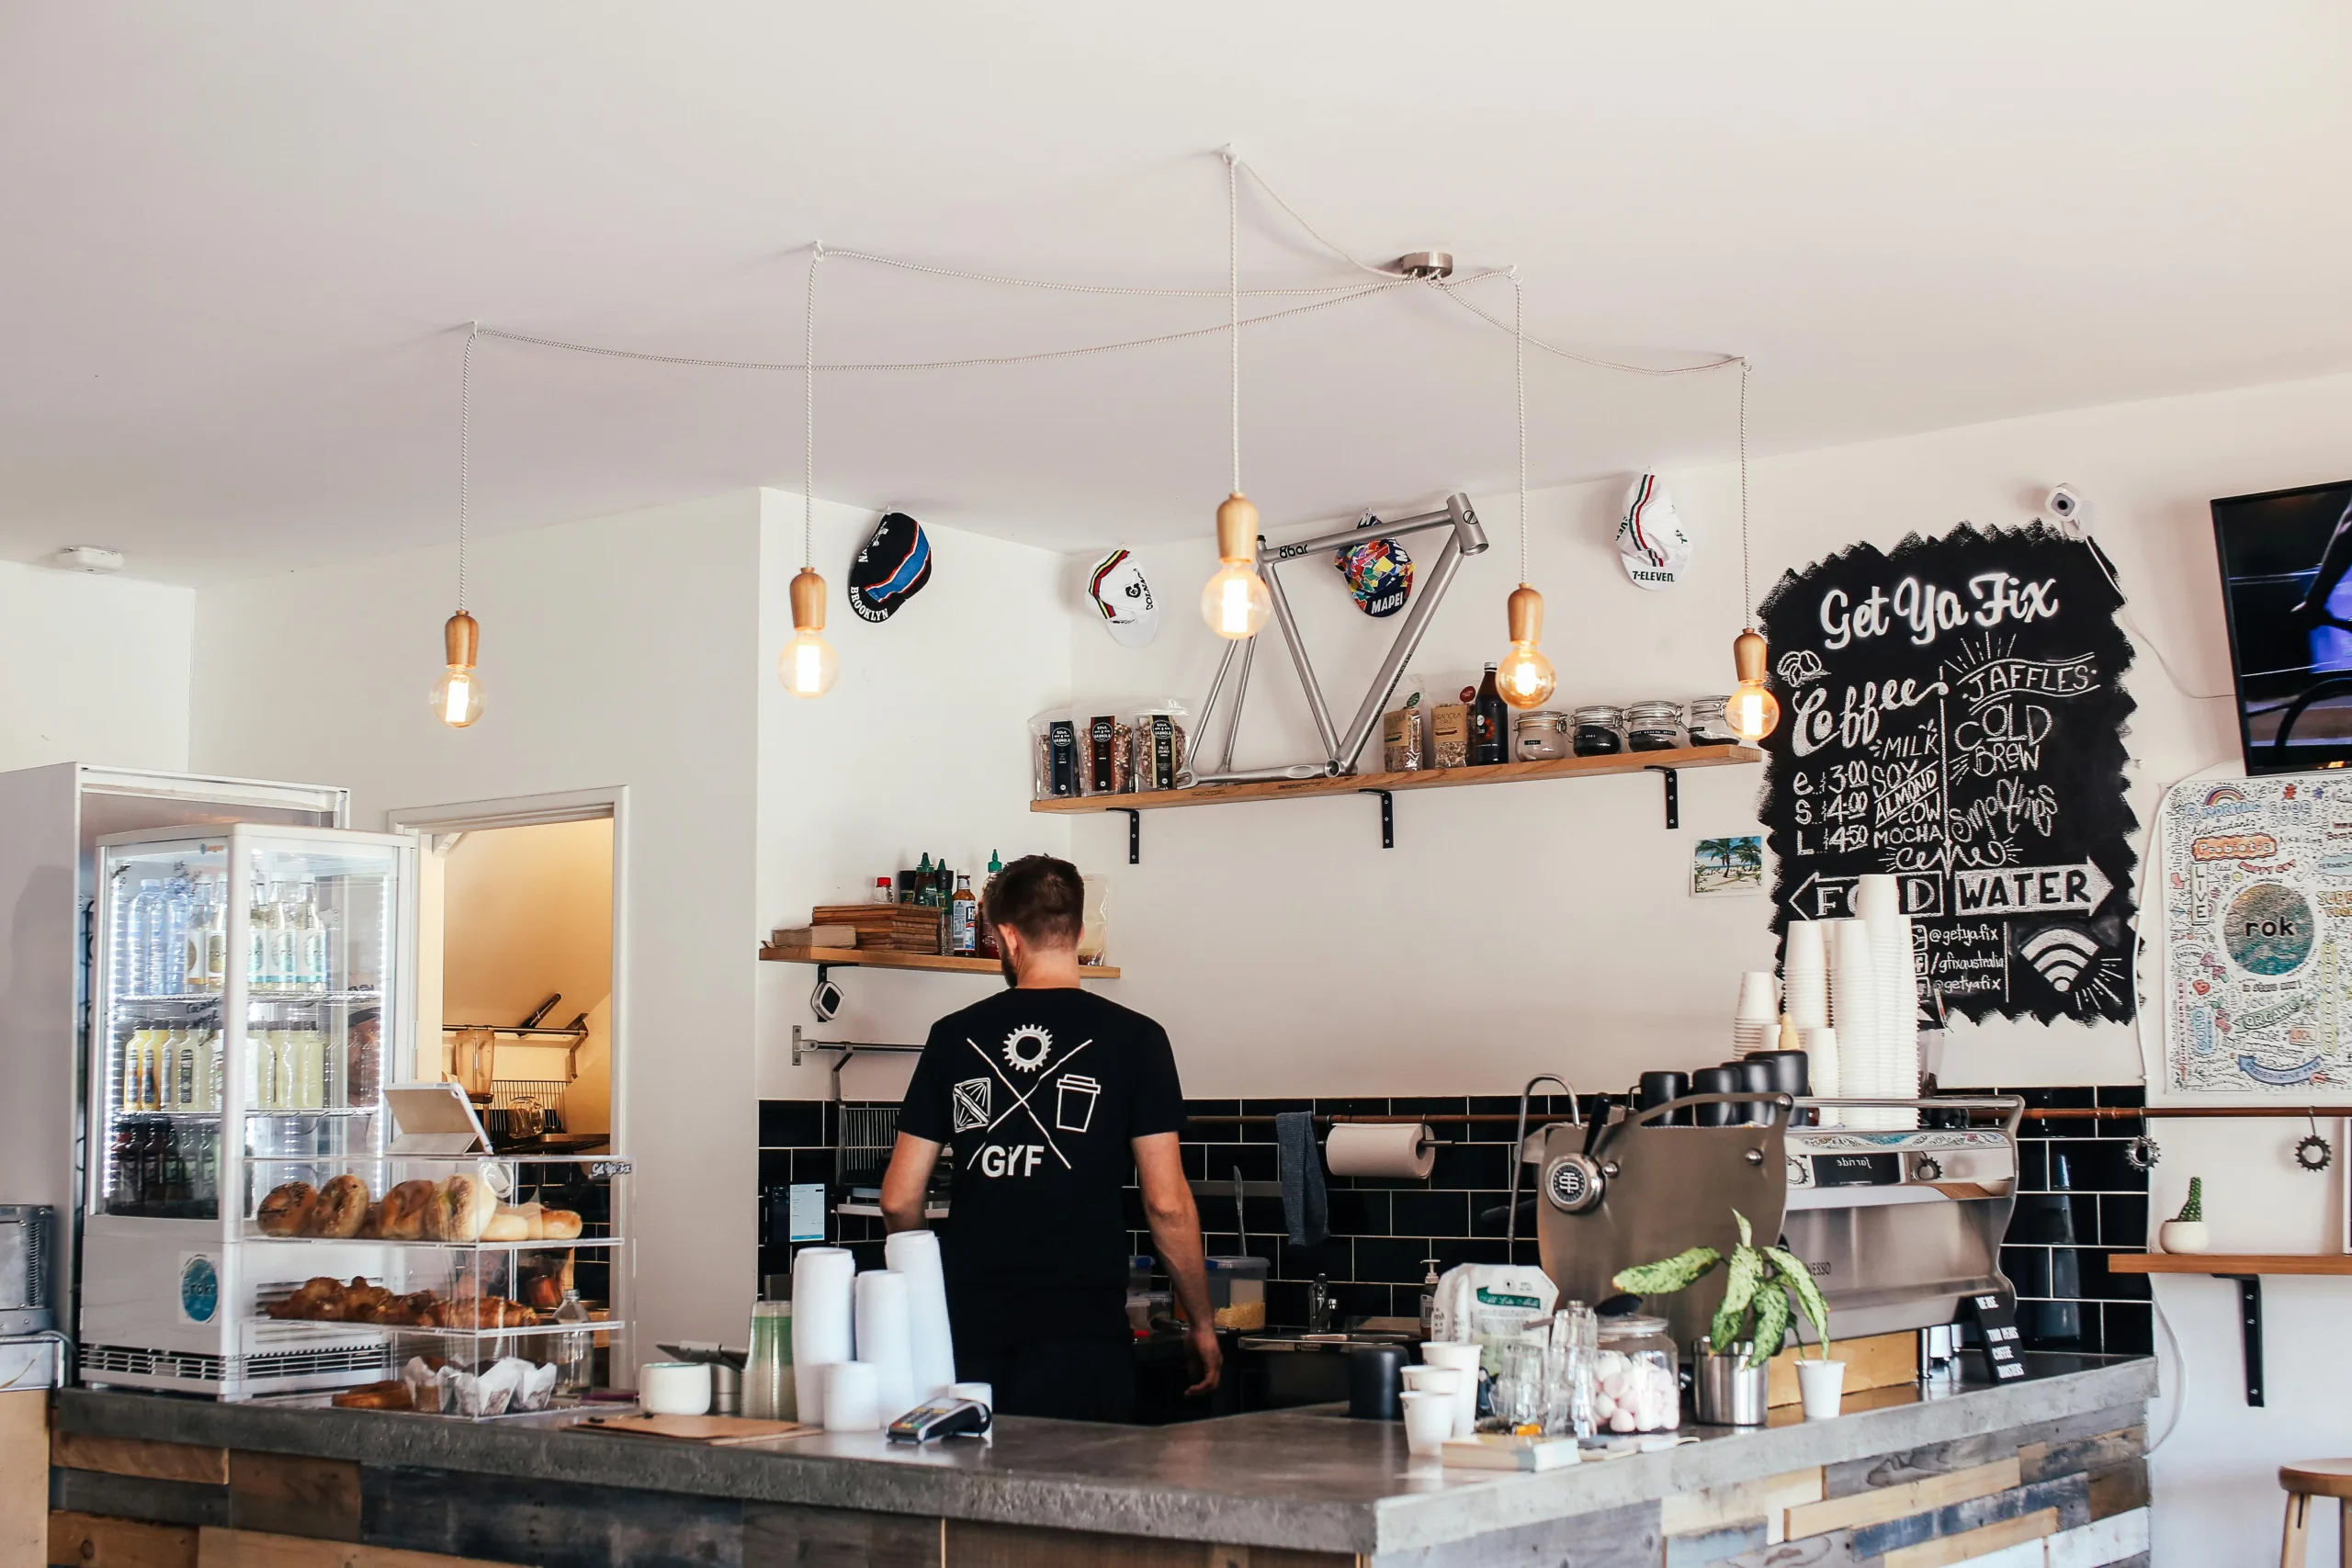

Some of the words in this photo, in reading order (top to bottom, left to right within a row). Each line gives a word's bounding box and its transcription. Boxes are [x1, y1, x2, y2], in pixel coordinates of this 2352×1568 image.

[1279, 544, 1308, 558] 8bar
[851, 586, 888, 621] BROOKLYN
[1372, 592, 1404, 615] MAPEI
[1820, 585, 1889, 649] Get
[1894, 577, 1969, 645] Ya
[1969, 572, 2059, 627] Fix
[1968, 664, 2089, 703] JAFFLES
[1792, 678, 1949, 757] Coffee
[1954, 703, 2052, 750] COLD
[1883, 733, 1939, 761] MILK
[1871, 759, 1919, 798] SOY
[1875, 769, 1938, 825] ALMOND
[1898, 792, 1940, 825] COW
[1873, 824, 1945, 849] MOCHA
[1815, 879, 1935, 917] FD
[1960, 870, 2092, 911] WATER
[2195, 866, 2207, 919] LIVE
[2245, 916, 2296, 937] rok
[981, 1145, 1045, 1178] GYF
